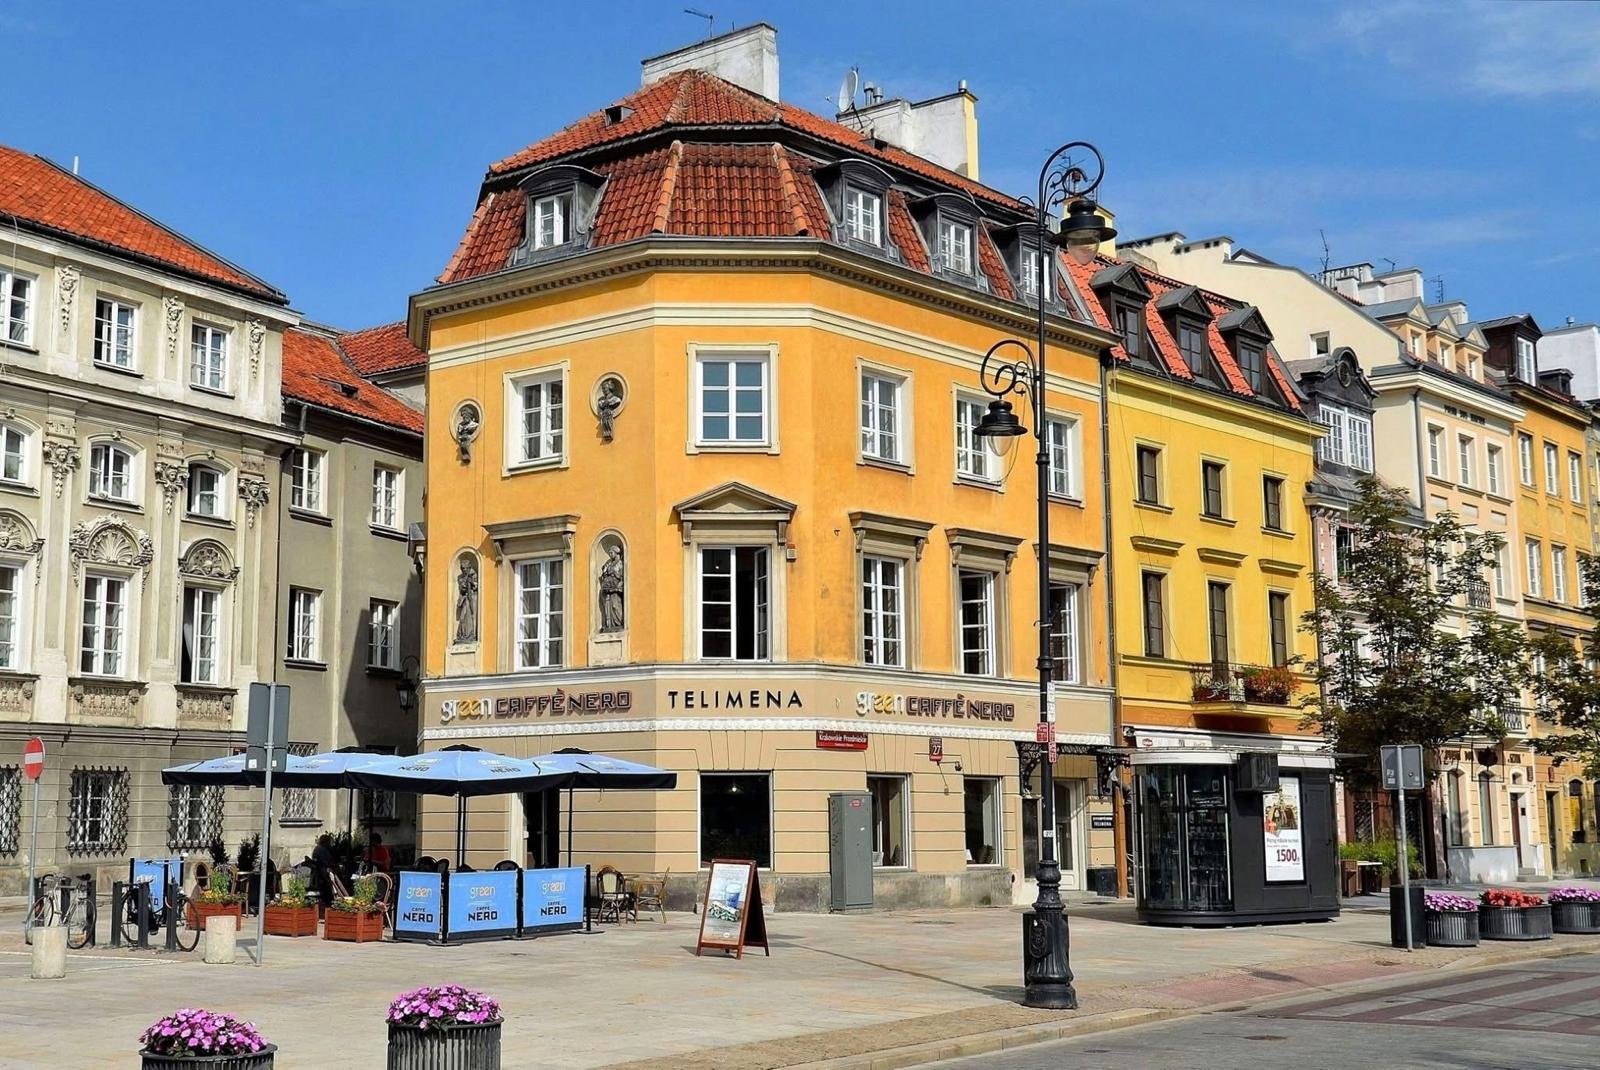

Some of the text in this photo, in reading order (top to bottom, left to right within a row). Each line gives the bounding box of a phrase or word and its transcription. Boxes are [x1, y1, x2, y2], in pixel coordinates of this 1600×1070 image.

[668, 690, 803, 709] TELIMENA
[440, 697, 492, 722] green
[567, 691, 632, 714] NERO
[855, 690, 904, 716] green
[966, 699, 1015, 722] NERO
[1276, 849, 1297, 862] 1500
[406, 887, 432, 899] green
[469, 887, 496, 899] green
[540, 880, 566, 895] green
[468, 911, 498, 921] NERO
[540, 905, 567, 916] NERO
[403, 912, 434, 922] NERO
